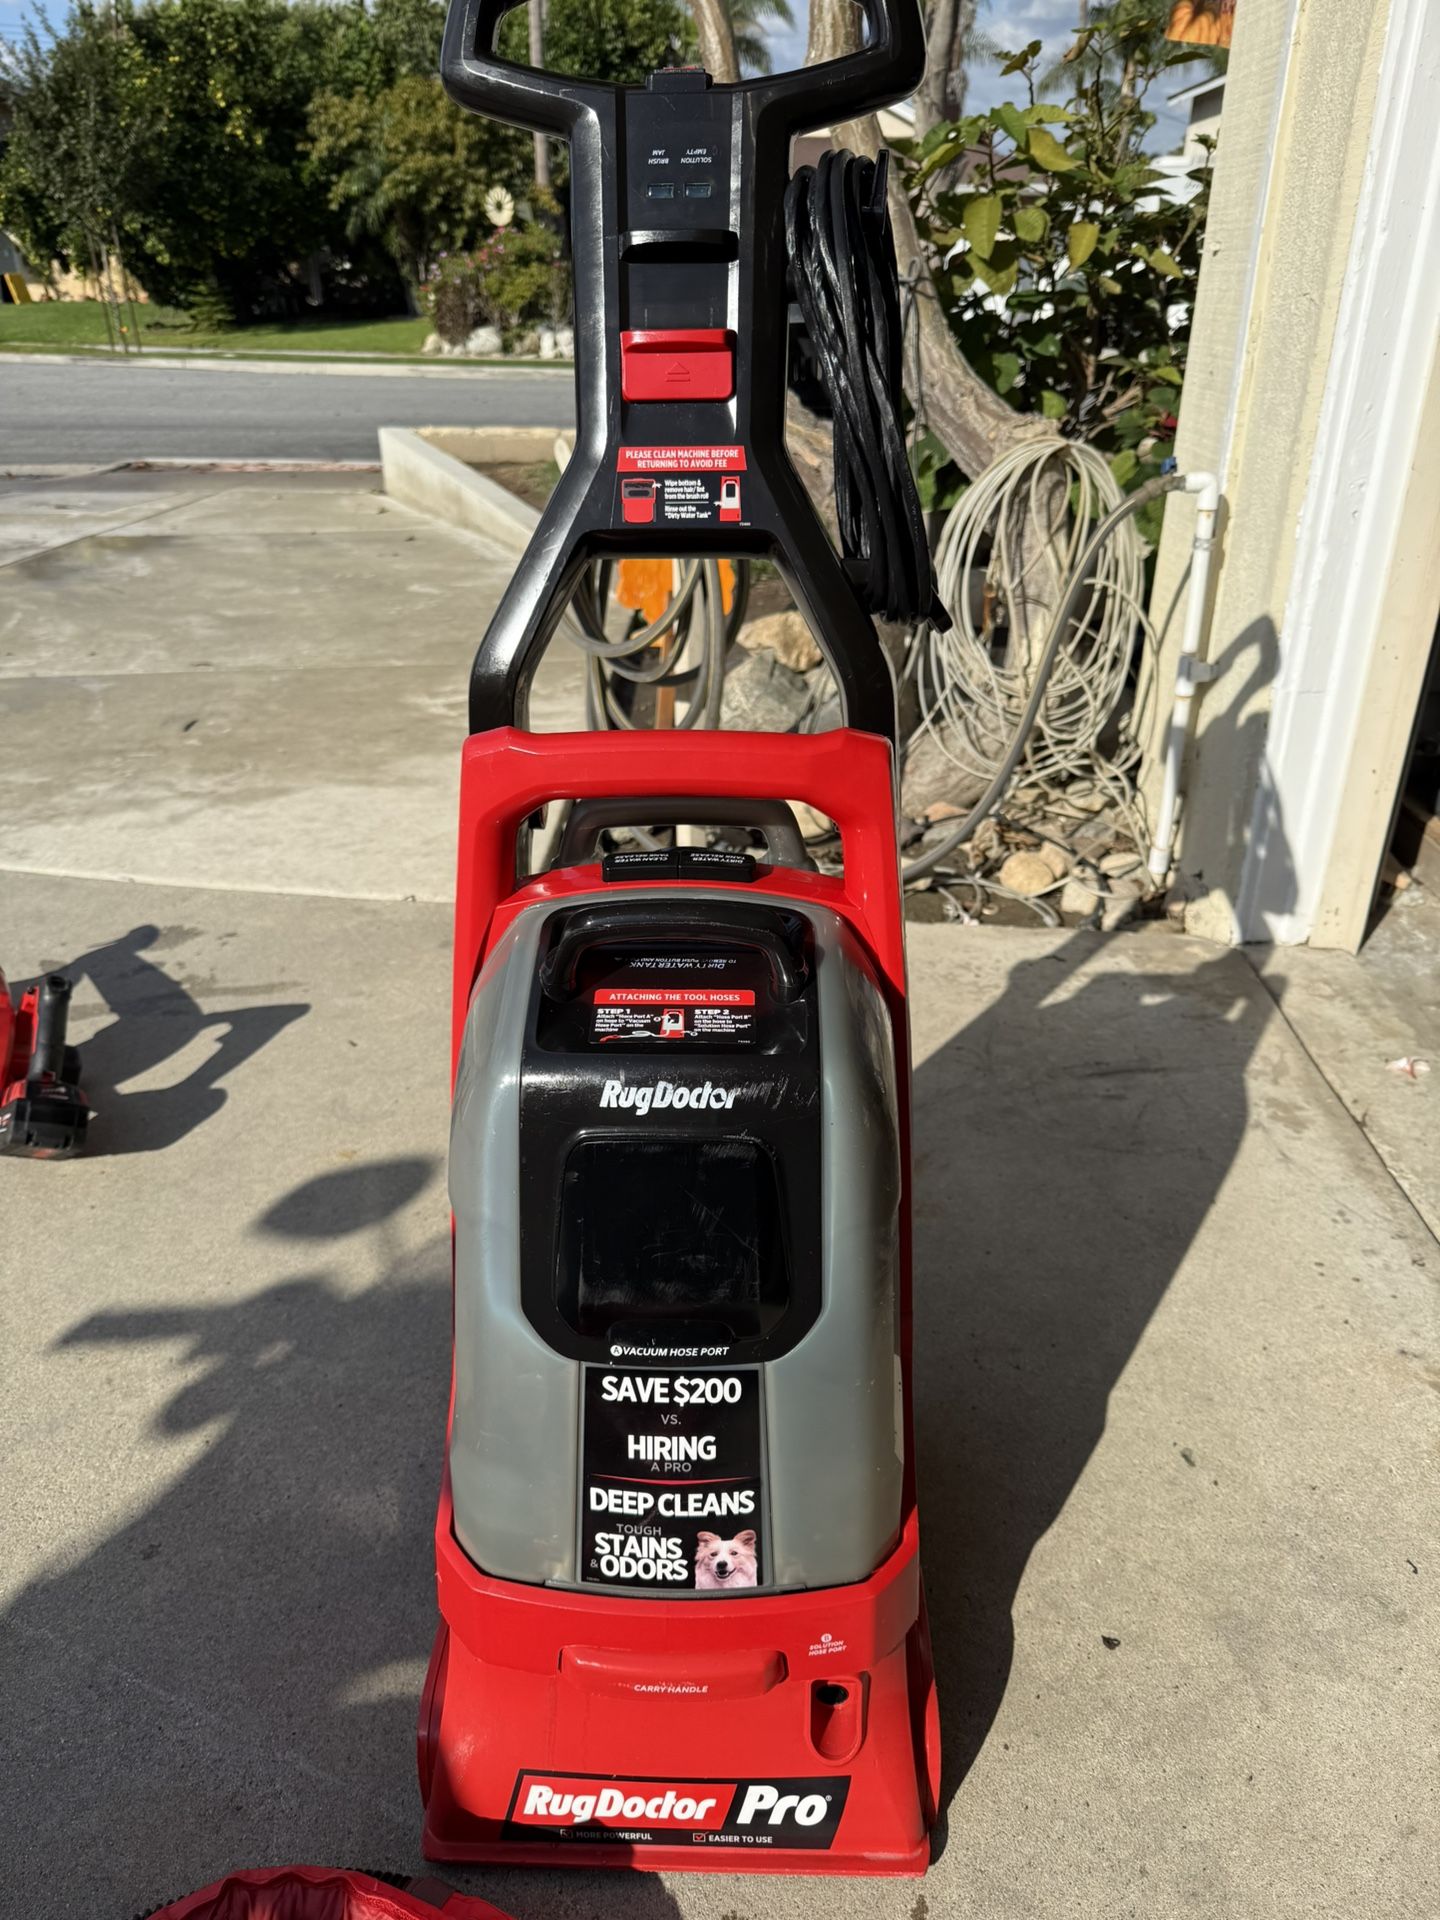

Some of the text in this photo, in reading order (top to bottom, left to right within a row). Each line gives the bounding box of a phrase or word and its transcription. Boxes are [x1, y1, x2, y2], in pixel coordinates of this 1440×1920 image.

[626, 449, 739, 459] PLEASE CLEAN MACHINE BEFORE
[637, 459, 728, 468] RETURNING TO AVOID FEE
[599, 1080, 736, 1116] RugDoctor
[623, 1346, 668, 1356] VACUUM
[669, 1348, 698, 1356] HOSE
[700, 1346, 730, 1356] PORT
[601, 1376, 742, 1407] SAVE $200
[661, 1414, 682, 1425] VS.
[628, 1434, 717, 1461] HIRING
[650, 1462, 692, 1473] A PRO
[590, 1487, 755, 1517] DEEP CLEANS
[616, 1523, 662, 1536] TOUGH
[594, 1532, 683, 1559] STAINS
[590, 1555, 688, 1581] & ODORS
[809, 1640, 844, 1650] SOLUTION
[828, 1645, 847, 1654] PORT
[634, 1684, 709, 1693] CARRY HANDLE
[524, 1784, 716, 1823] RugDoctor
[603, 1832, 653, 1840] POWERFUL
[708, 1835, 740, 1843] EASIER
